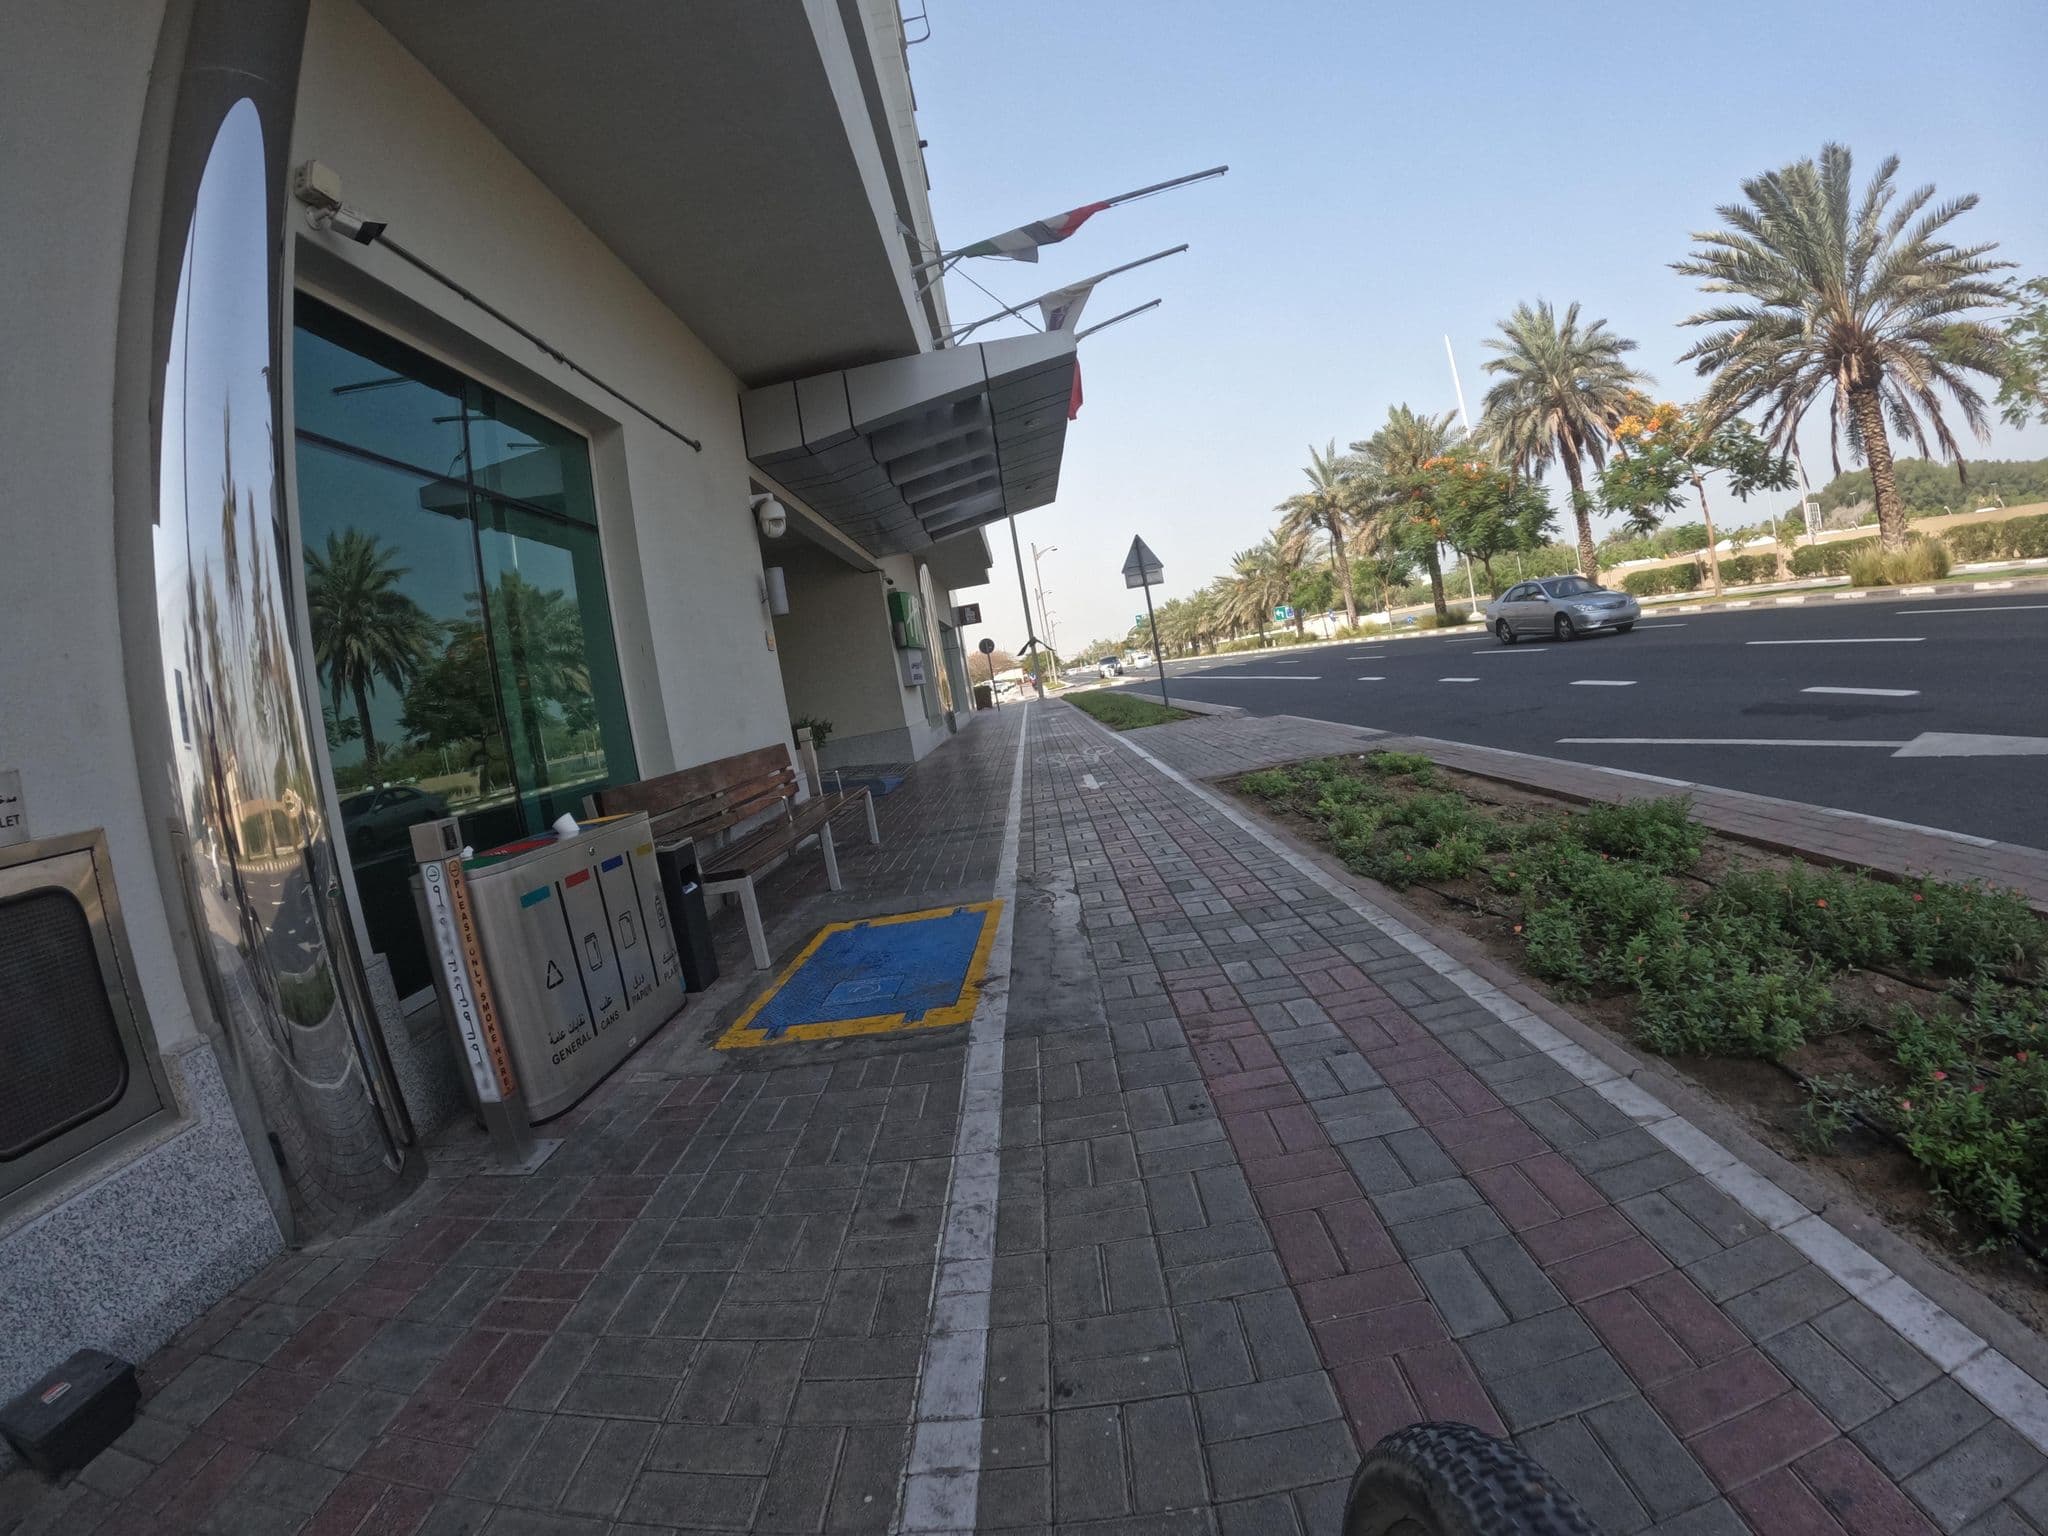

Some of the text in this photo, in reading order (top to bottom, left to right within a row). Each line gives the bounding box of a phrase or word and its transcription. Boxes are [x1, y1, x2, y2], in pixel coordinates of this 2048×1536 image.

[455, 880, 472, 942] PLEASE
[469, 948, 483, 987] ONLY
[480, 993, 496, 1042] SMOKE
[600, 1010, 621, 1031] CANS
[551, 1031, 593, 1065] GENERAL
